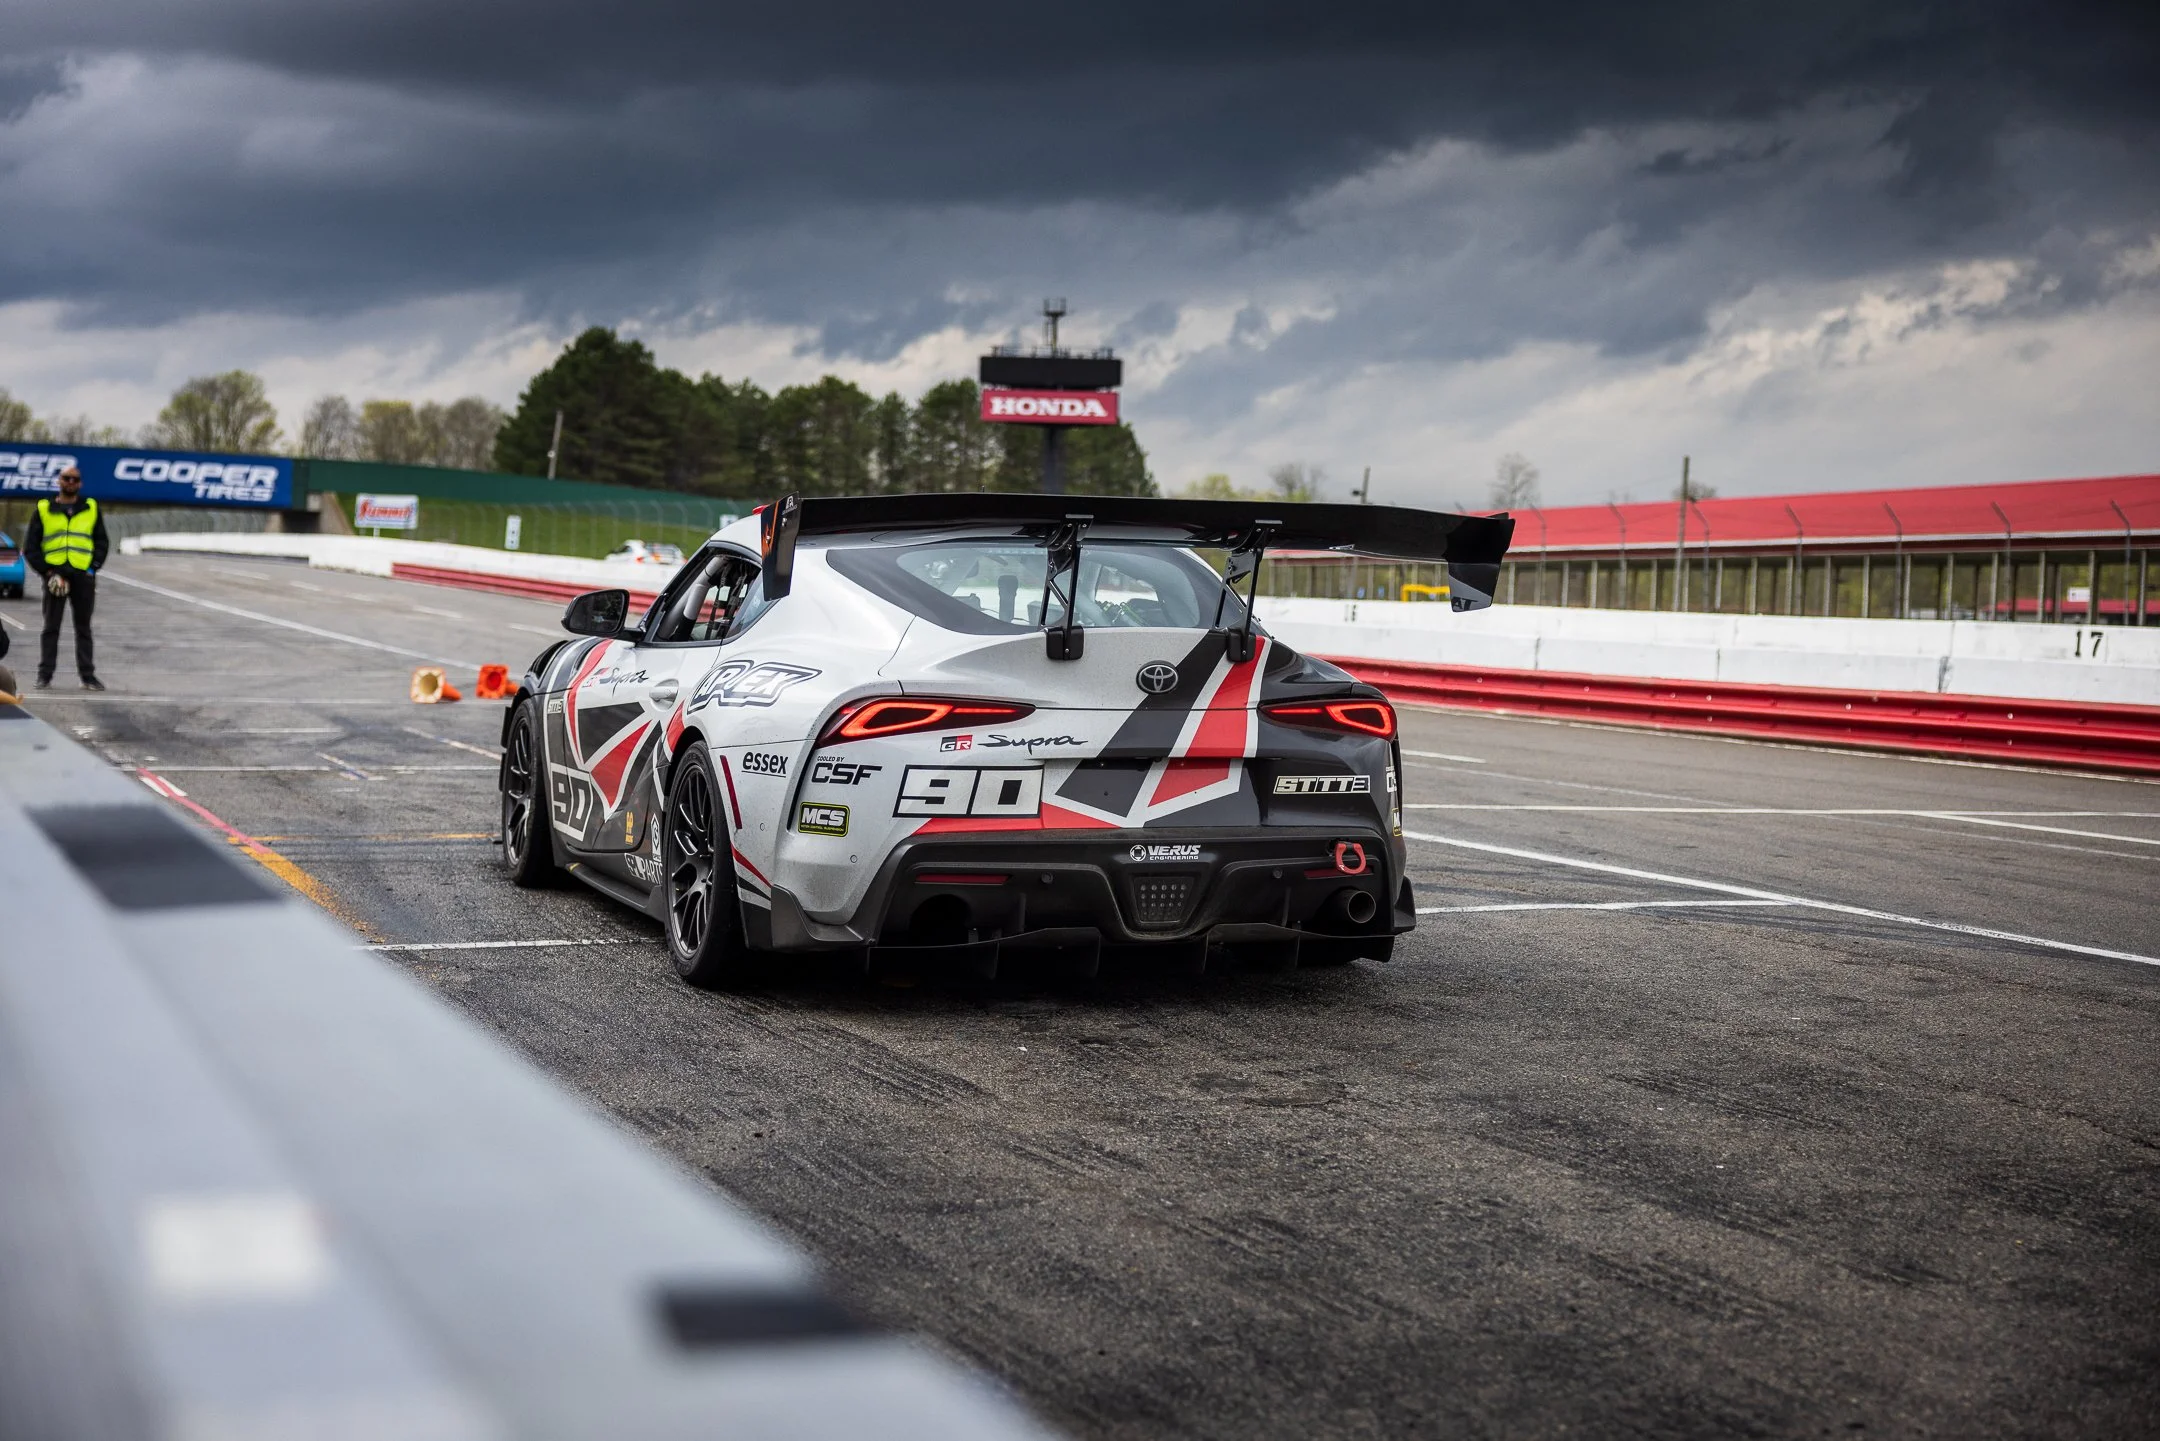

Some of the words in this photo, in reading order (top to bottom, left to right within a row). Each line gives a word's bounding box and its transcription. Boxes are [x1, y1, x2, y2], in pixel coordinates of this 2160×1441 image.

[989, 397, 1108, 417] HONDA
[0, 472, 61, 491] IRES
[113, 457, 278, 488] COOPER
[192, 483, 275, 502] TIRES
[2074, 630, 2104, 658] 17
[940, 738, 972, 752] GR
[978, 734, 1088, 755] Supra
[742, 751, 788, 775] essex
[811, 762, 883, 785] CSF
[551, 765, 592, 839] 90
[894, 766, 1044, 817] 90
[801, 807, 846, 826] MCS
[1147, 845, 1202, 856] VERUS
